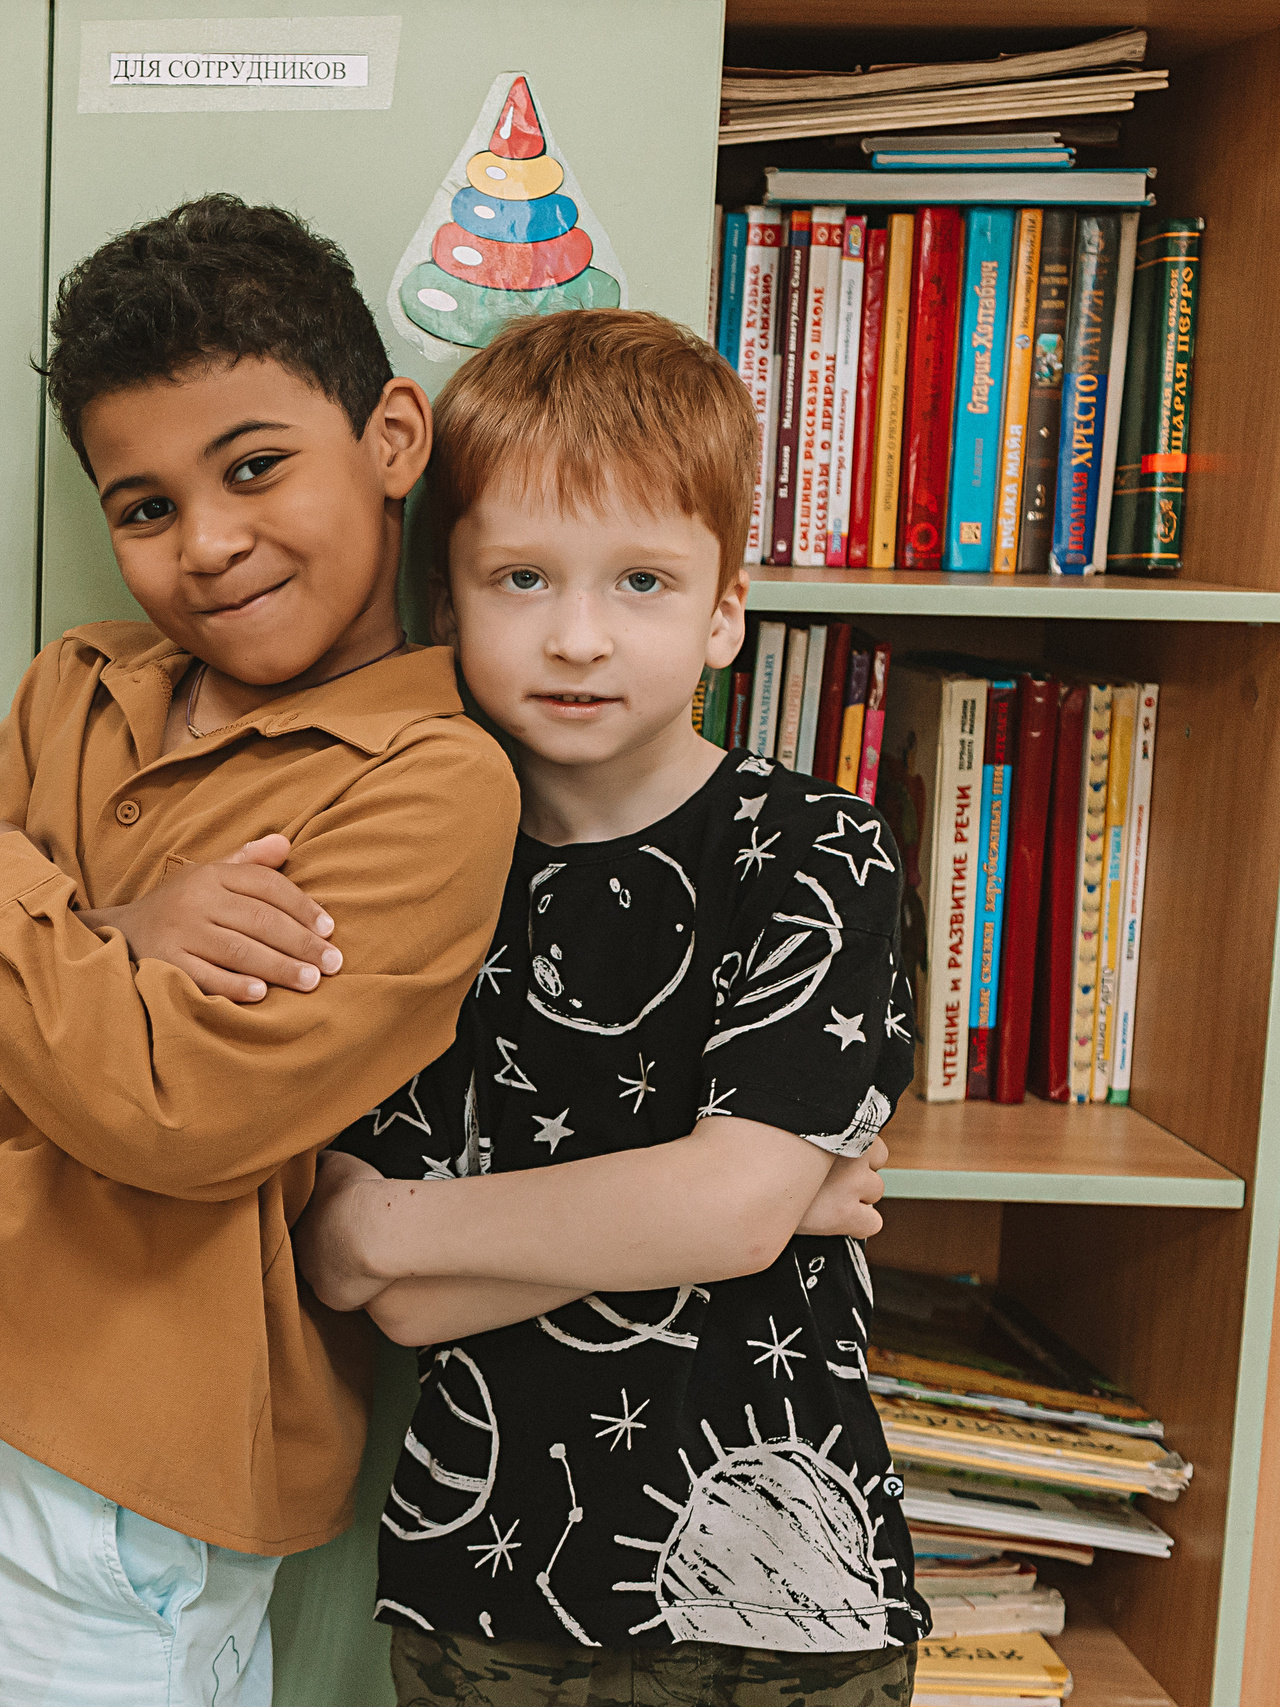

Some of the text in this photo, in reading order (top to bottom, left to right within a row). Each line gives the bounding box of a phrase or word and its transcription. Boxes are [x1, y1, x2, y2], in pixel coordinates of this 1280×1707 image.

[114, 59, 347, 83] ДЛЯ СОТРУДНИКОВ
[746, 263, 760, 328] КУЗЬКА
[1167, 268, 1178, 326] СКАЗОК
[757, 356, 767, 381] ЭТО
[967, 260, 999, 414] Старик Хоттабыч
[1164, 332, 1176, 382] КНИГА
[1169, 266, 1195, 453] ШАРЛЯ ПЕРРО
[755, 389, 765, 413] ГДЕ
[782, 352, 795, 428] Малахитовая
[1070, 288, 1107, 468] ХРЕСТОМАТИЯ
[799, 287, 824, 551] СМЕШНЫЕ РАССКАЗЫ О ШКОЛЕ
[813, 353, 837, 553] РАССКАЗЫ О ПРИРОДЕ
[1003, 424, 1022, 477] МАЙЯ
[779, 444, 791, 483] Бажов
[1066, 471, 1090, 550] ПОЛНАЯ
[954, 784, 972, 843] РЕЧИ
[981, 799, 1006, 911] зарубежных
[947, 849, 968, 969] РАЗВИТИЕ
[980, 922, 994, 983] сказки
[941, 1000, 960, 1086] ЧТЕНИЕ
